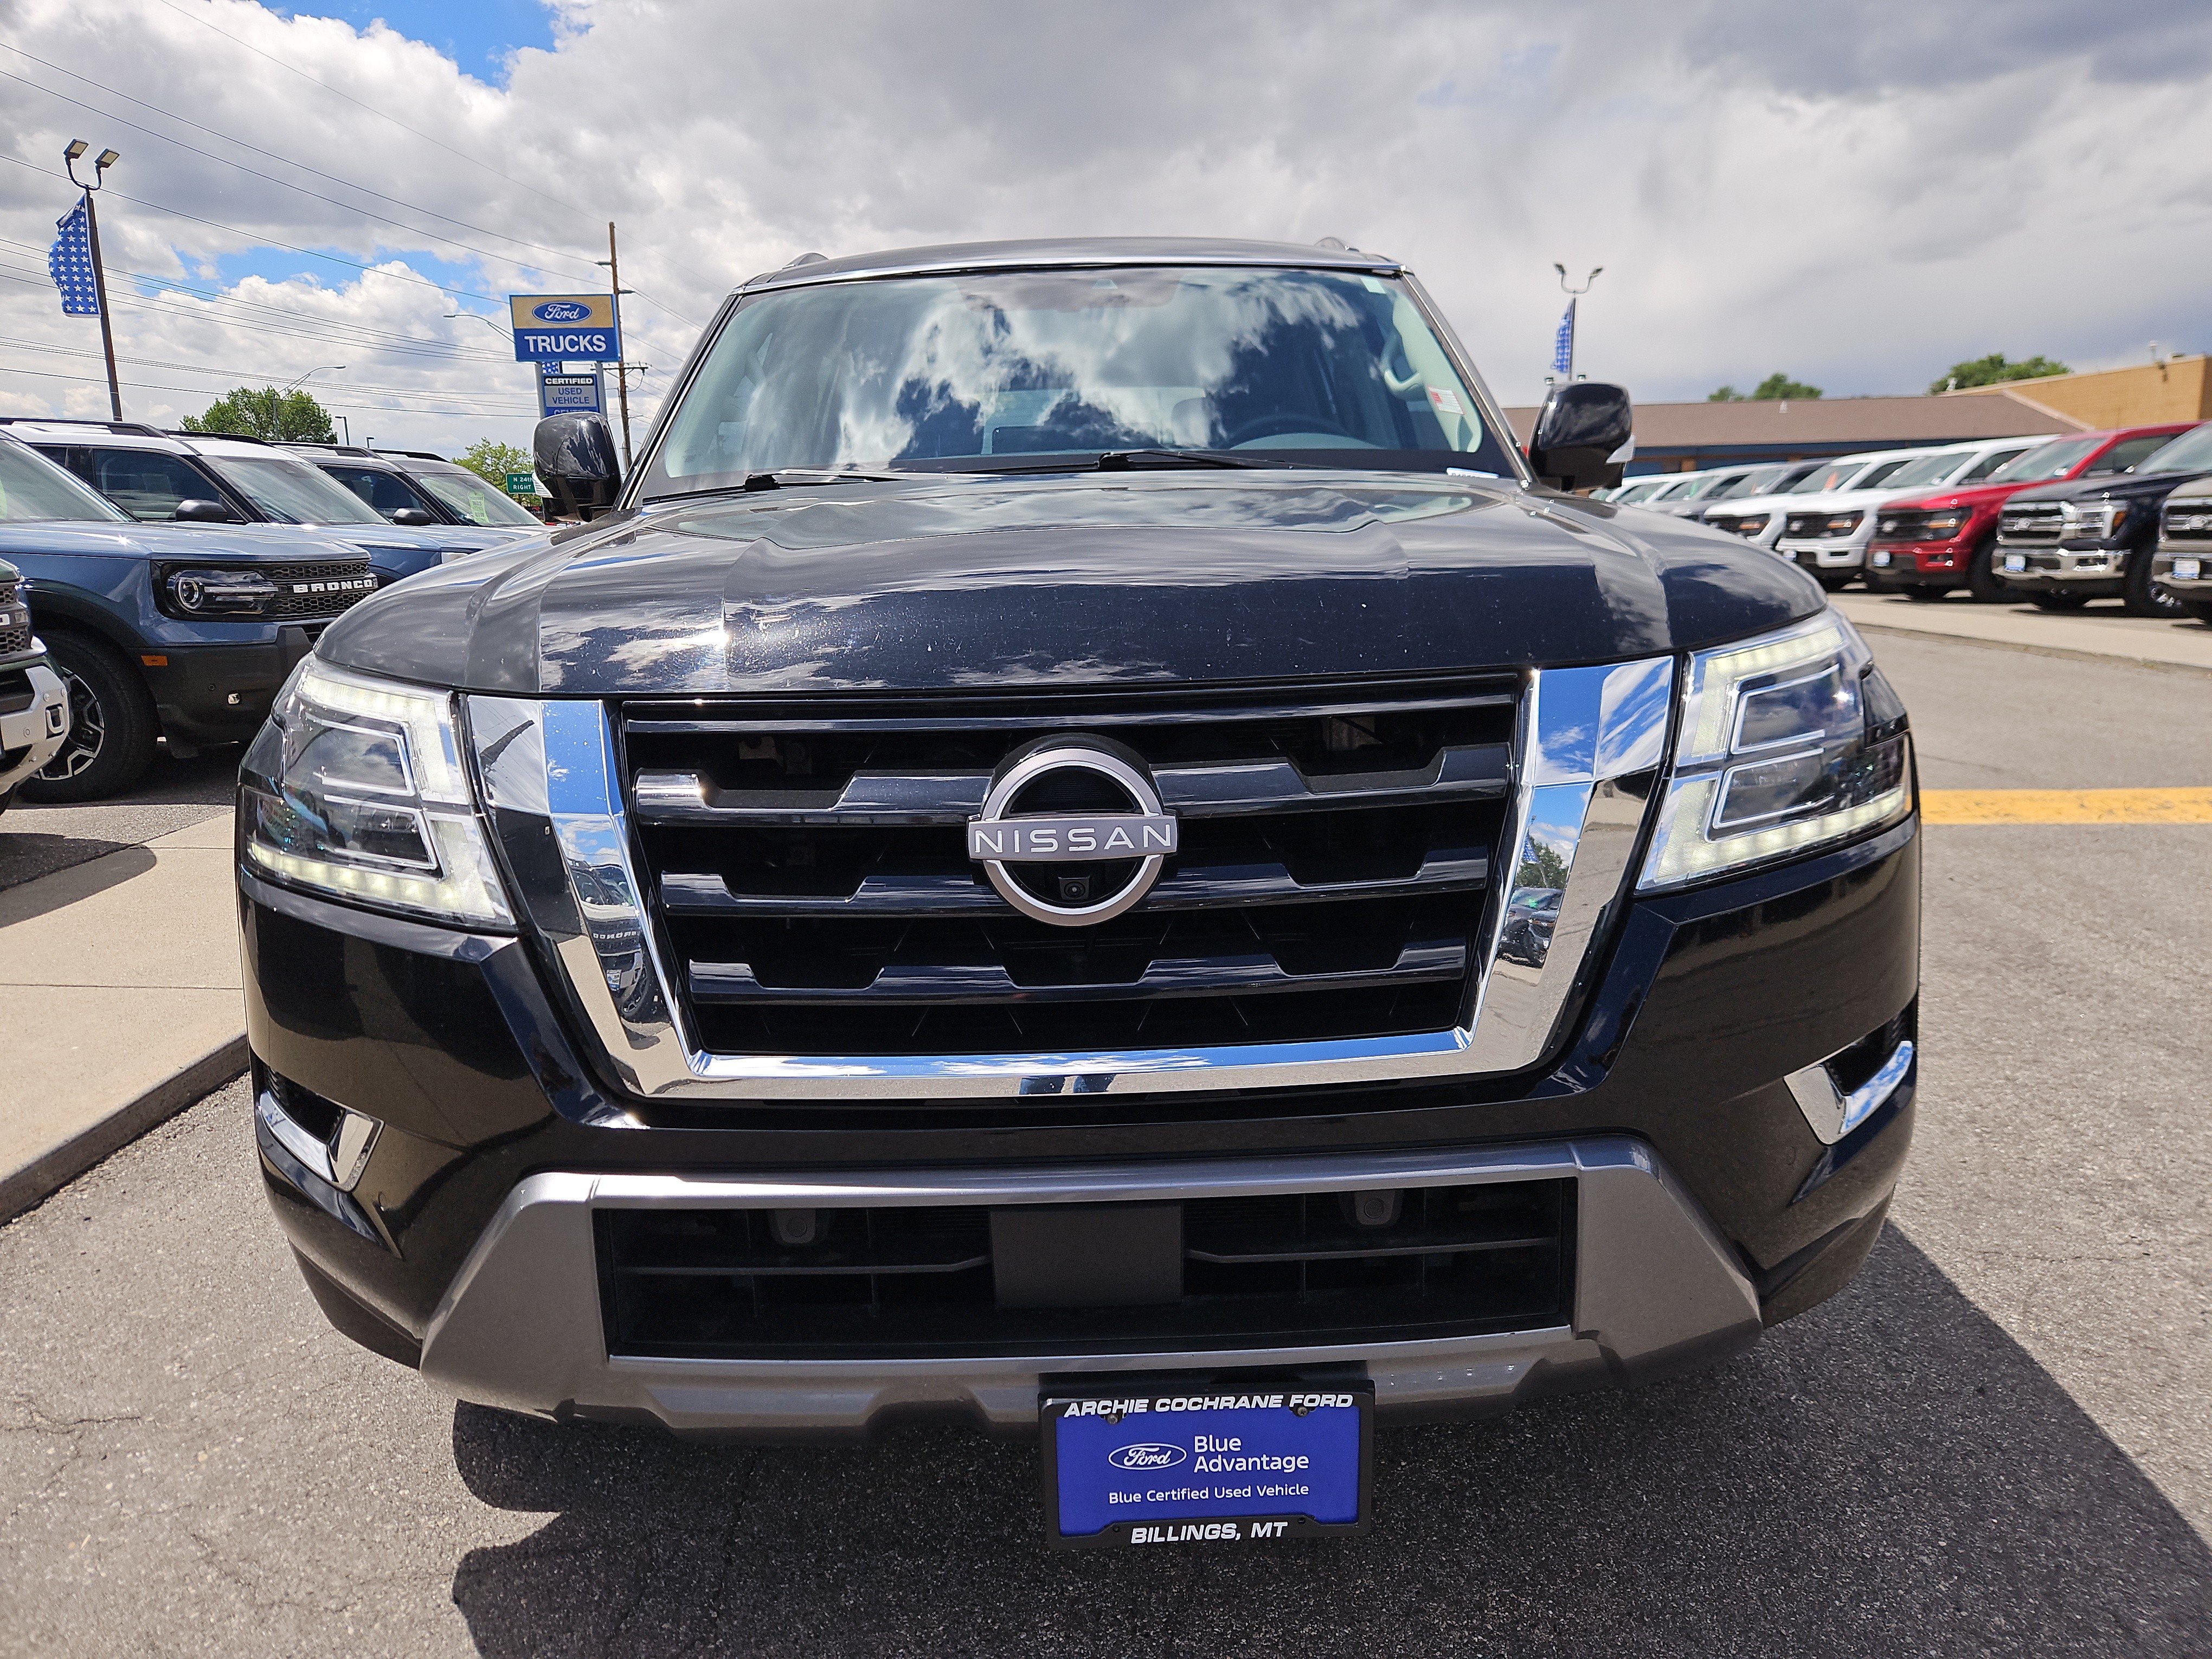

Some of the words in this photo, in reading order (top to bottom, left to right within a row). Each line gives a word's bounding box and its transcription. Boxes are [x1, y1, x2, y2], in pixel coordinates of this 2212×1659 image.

[544, 304, 580, 319] Ford
[524, 334, 607, 352] TRUCKS
[552, 396, 590, 404] VEHICLE
[558, 387, 582, 395] USED
[293, 579, 372, 593] BRONCO
[975, 824, 1171, 853] NISSAN
[1063, 1398, 1149, 1418] ARCHIE
[1155, 1394, 1284, 1412] COCHRANE
[1289, 1394, 1354, 1409] FORD
[1194, 1435, 1242, 1453] Blue
[1123, 1446, 1171, 1466] Ford
[1193, 1454, 1309, 1473] Advantage
[1109, 1491, 1141, 1504] Blue
[1146, 1487, 1209, 1502] Certified
[1214, 1485, 1251, 1499] Used
[1256, 1483, 1309, 1497] Vehicle
[1130, 1523, 1241, 1544] BILLINGS,
[1250, 1522, 1289, 1538] MT
